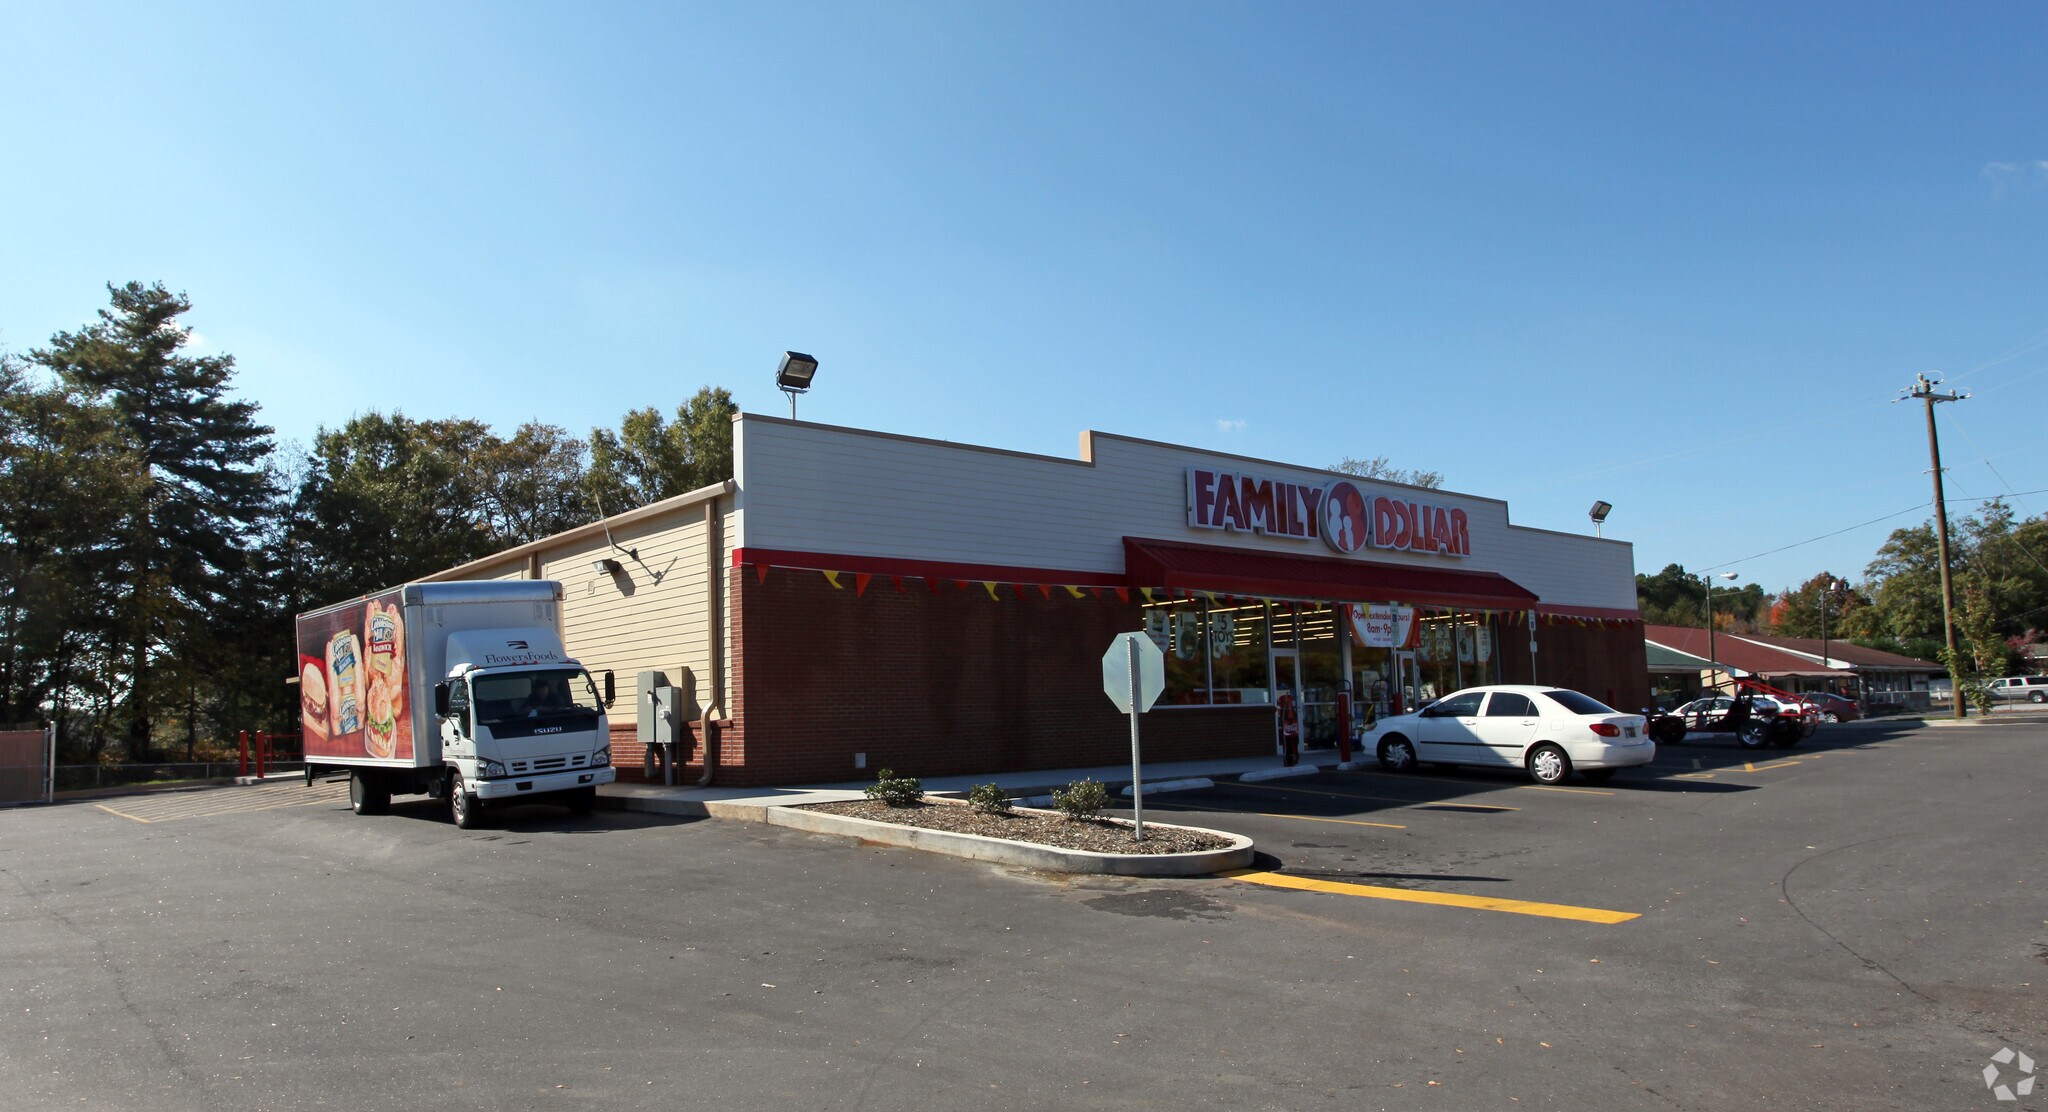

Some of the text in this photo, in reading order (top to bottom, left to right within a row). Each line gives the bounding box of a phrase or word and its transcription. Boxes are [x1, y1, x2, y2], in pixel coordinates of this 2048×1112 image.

[1194, 470, 1471, 555] FAMILY DOLLAR
[534, 726, 562, 735] ISUZU
